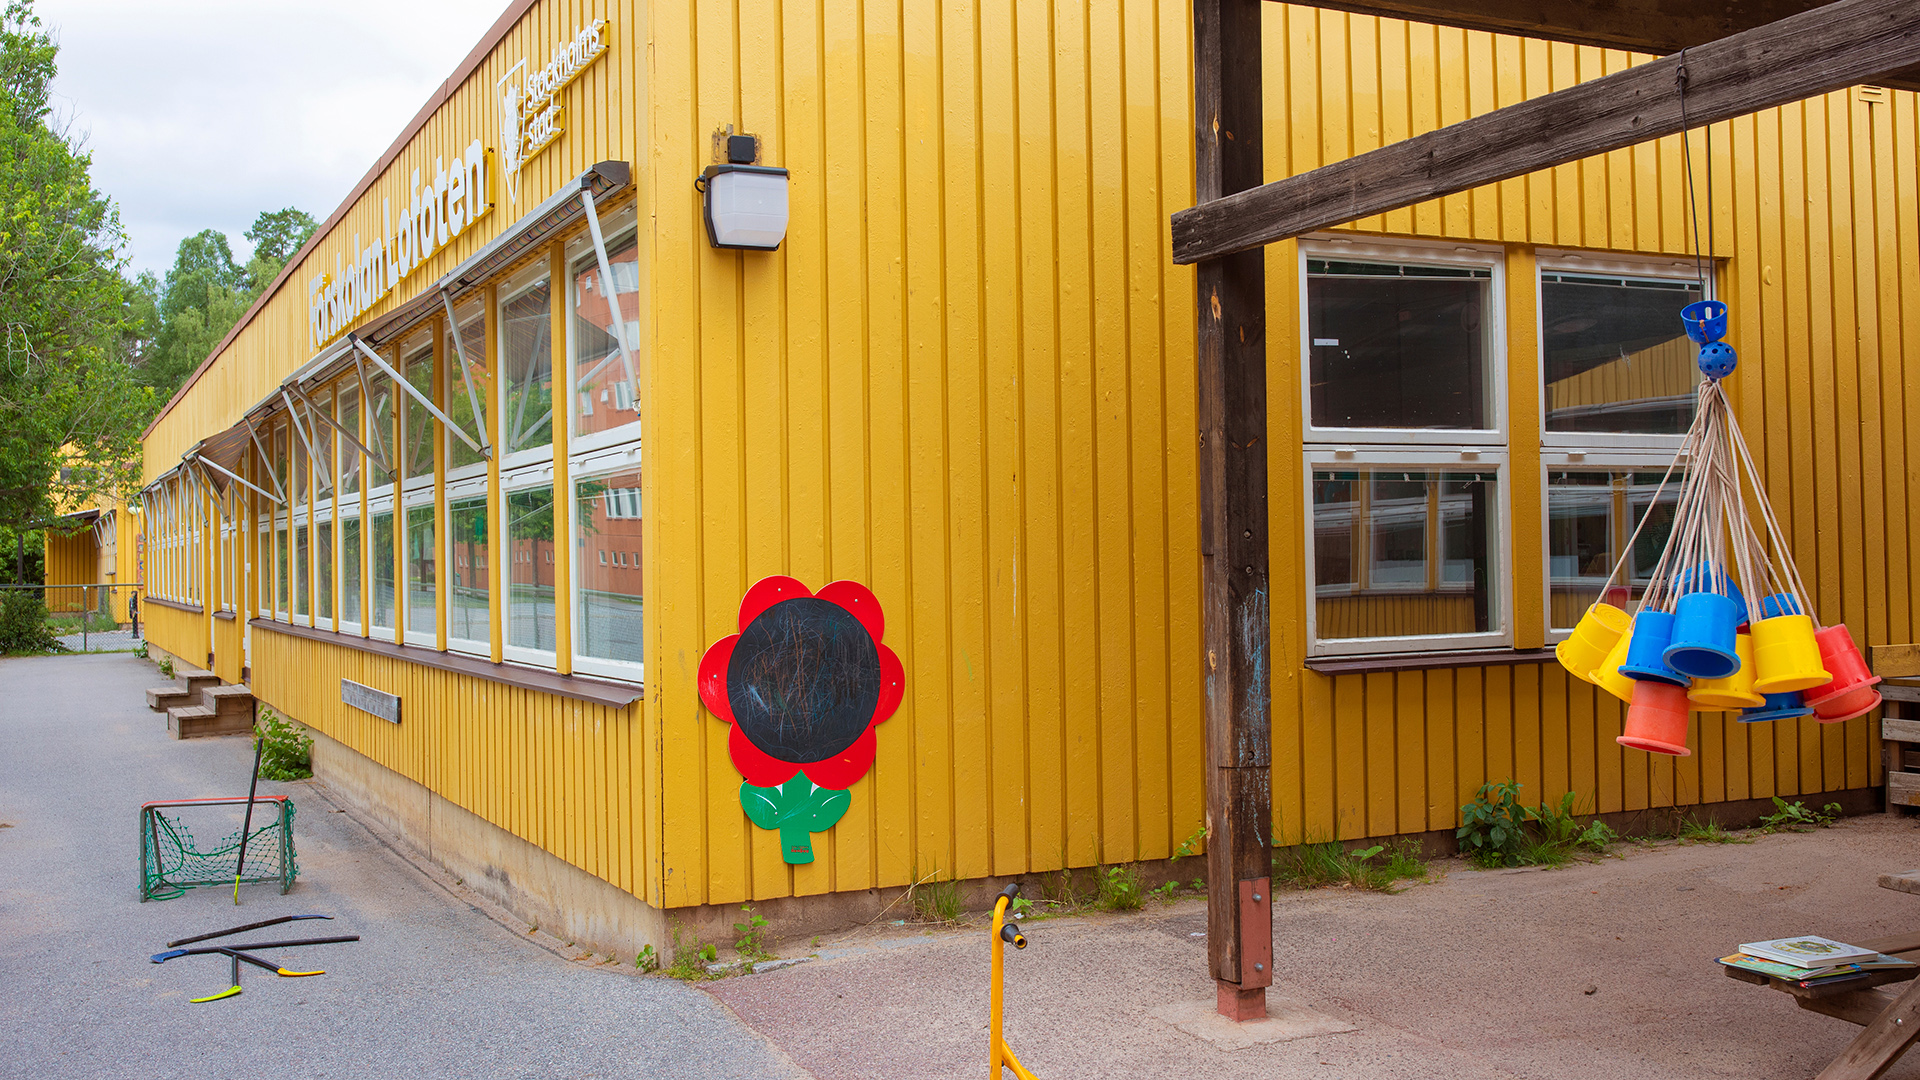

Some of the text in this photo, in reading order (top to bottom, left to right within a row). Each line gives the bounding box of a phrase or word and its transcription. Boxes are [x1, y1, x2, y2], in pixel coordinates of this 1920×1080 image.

[527, 18, 600, 109] Stockholms
[528, 93, 554, 151] stad
[309, 138, 484, 353] Förskolan Lofoten
